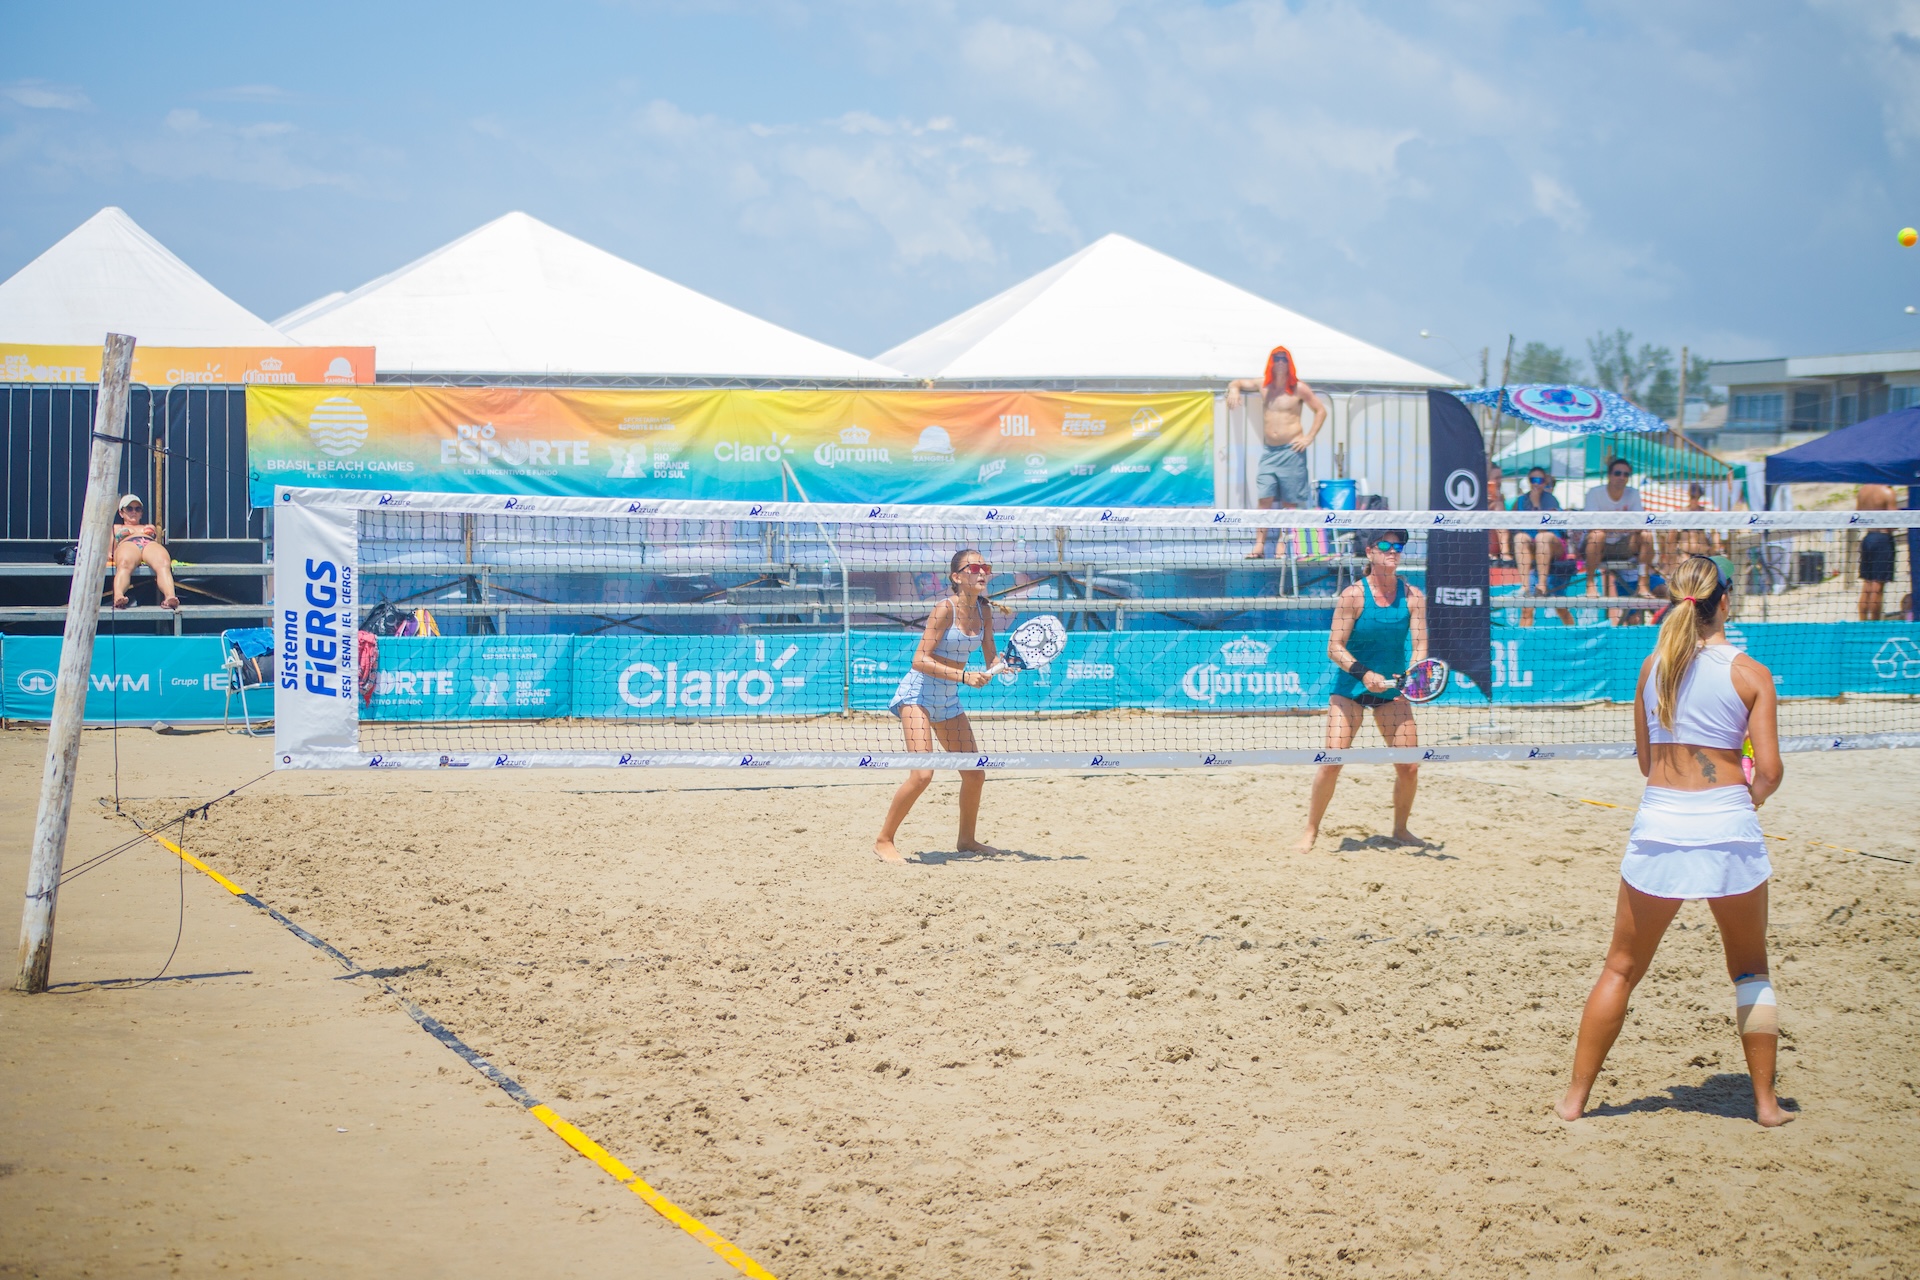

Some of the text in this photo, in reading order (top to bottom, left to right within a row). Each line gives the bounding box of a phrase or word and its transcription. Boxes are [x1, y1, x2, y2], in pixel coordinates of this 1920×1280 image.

[166, 368, 214, 383] Claro
[242, 369, 297, 384] Corona
[457, 422, 496, 441] pró
[1000, 415, 1036, 437] JBL
[440, 438, 590, 466] ESPORTE
[653, 453, 670, 461] RIO
[713, 438, 782, 463] Claro
[814, 441, 892, 468] Corona
[267, 459, 414, 472] BRASIL BEACH GAMES
[653, 461, 690, 470] GRANDE
[1069, 465, 1097, 476] JET
[653, 470, 686, 479] DO SUL
[378, 493, 411, 506] Azzure
[504, 497, 535, 511] Azzure
[628, 501, 659, 514] Azzure
[750, 504, 779, 517] Azzure
[868, 507, 898, 519] Azzure
[985, 508, 1015, 521] Azzure
[1100, 509, 1129, 522] Azzure
[1213, 511, 1241, 523] Azzure
[1325, 512, 1352, 524] Azzure
[1435, 586, 1482, 606] IESA
[342, 566, 351, 699] SESI SENAI IEL CIERGS
[282, 610, 298, 690] Sistema
[853, 663, 877, 675] ITF
[1083, 663, 1115, 679] BRB
[87, 674, 149, 691] WM
[171, 677, 199, 687] Grupo
[204, 673, 233, 690] IE
[516, 681, 532, 690] RIO
[618, 661, 775, 708] Claro
[853, 676, 876, 684] Beach
[1182, 662, 1304, 704] Corona
[516, 689, 551, 697] GRANDE
[516, 697, 546, 706] DO SUL
[370, 754, 401, 767] Azzure
[495, 753, 526, 766] Azzure
[618, 753, 650, 766] Azzure
[740, 754, 771, 766] Azzure
[859, 755, 889, 767] Azzure
[976, 755, 1006, 768] Azzure
[1091, 754, 1120, 767] Azzure
[1203, 753, 1232, 765] Azzure
[1313, 751, 1342, 763] Azzure
